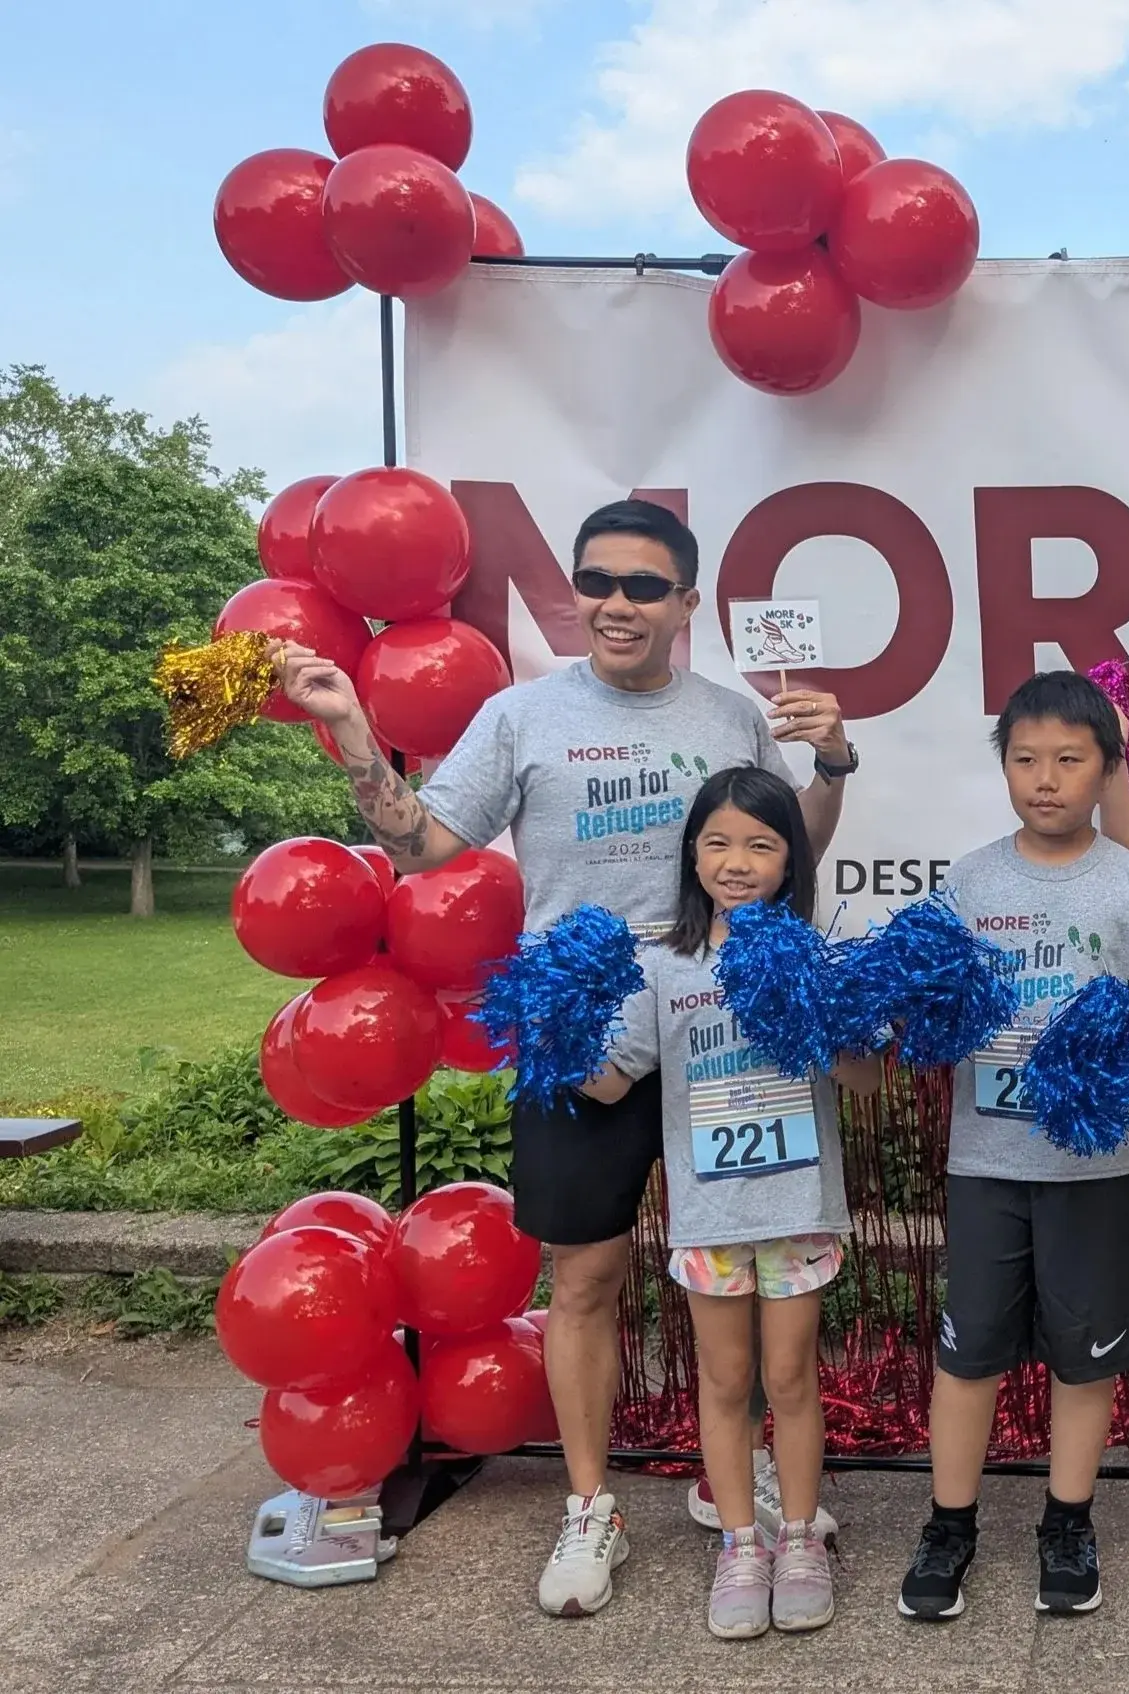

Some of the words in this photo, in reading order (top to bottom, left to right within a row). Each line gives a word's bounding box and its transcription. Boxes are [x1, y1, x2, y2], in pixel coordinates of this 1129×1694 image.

[765, 609, 795, 619] MORE
[780, 620, 793, 629] 5K
[568, 746, 630, 763] MORE
[587, 776, 631, 808] Run
[639, 767, 670, 797] for
[576, 796, 684, 842] Refugees
[608, 841, 652, 856] 2025
[835, 859, 951, 896] DESE
[976, 916, 1030, 932] MORE
[1034, 940, 1065, 969] for
[670, 989, 725, 1014] MORE
[689, 1022, 725, 1058] Run
[711, 1118, 788, 1170] 221
